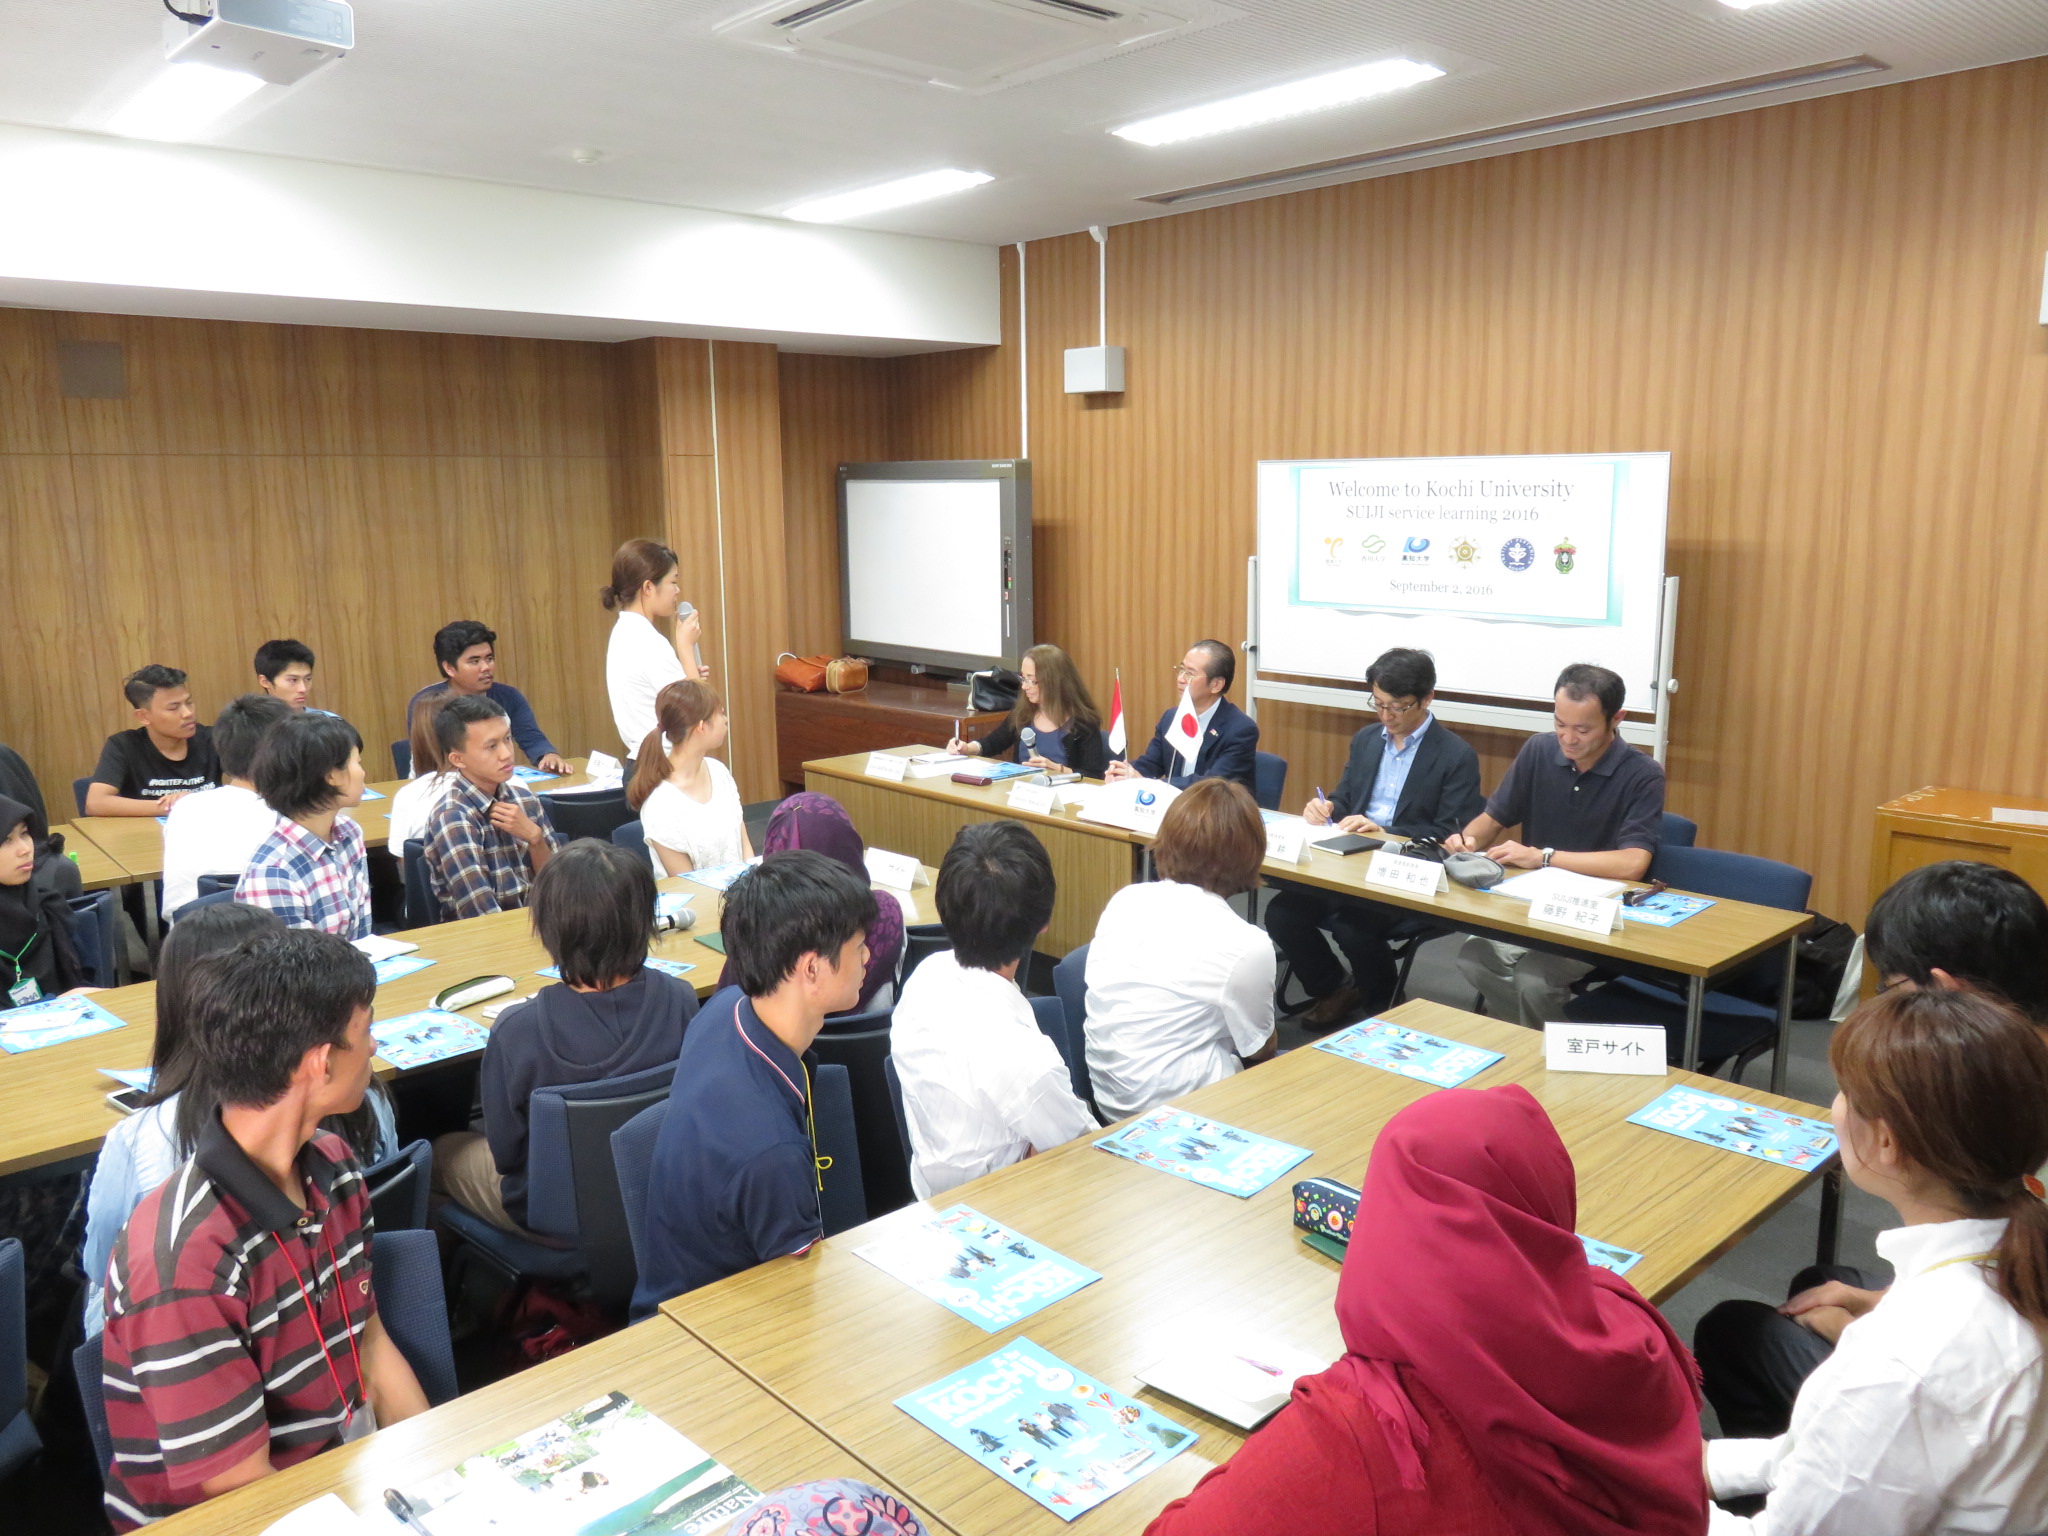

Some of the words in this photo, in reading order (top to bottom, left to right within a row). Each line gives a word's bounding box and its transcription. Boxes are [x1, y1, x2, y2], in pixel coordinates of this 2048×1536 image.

[1328, 480, 1400, 497] Welcome
[1404, 482, 1421, 497] to
[1426, 479, 1473, 497] Kochi
[1480, 478, 1575, 502] University
[1346, 504, 1384, 519] SUIJI
[1387, 505, 1435, 520] service
[1439, 505, 1498, 524] learning
[1502, 506, 1539, 521] 2016
[1401, 554, 1430, 562] 高知大学
[1389, 579, 1450, 594] September
[1452, 584, 1462, 595] 2,
[1465, 584, 1493, 595] 2016
[1406, 872, 1429, 886] 和也
[1574, 910, 1600, 925] 紀子
[1567, 1038, 1645, 1056] 室戸サイト
[968, 1263, 1077, 1319] KOCHI
[923, 1353, 1047, 1422] KOCHI
